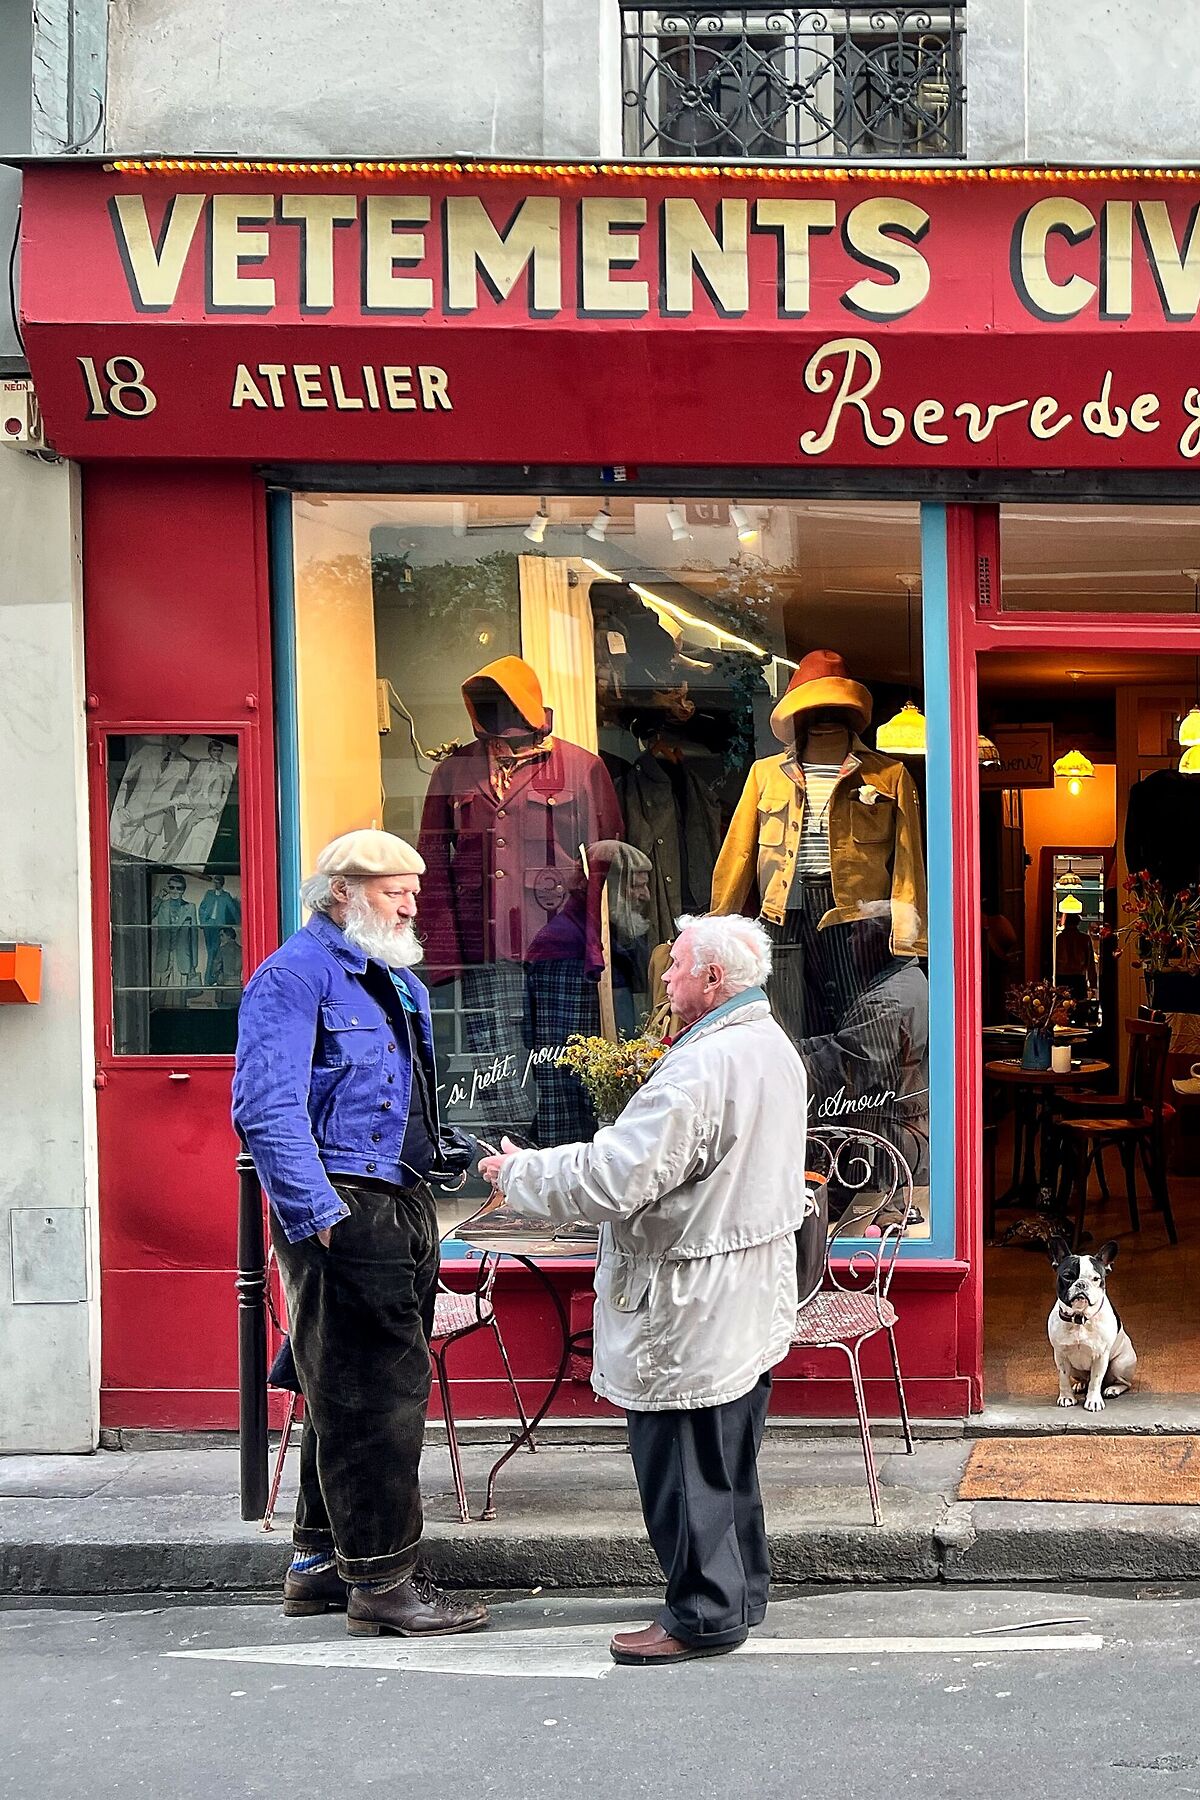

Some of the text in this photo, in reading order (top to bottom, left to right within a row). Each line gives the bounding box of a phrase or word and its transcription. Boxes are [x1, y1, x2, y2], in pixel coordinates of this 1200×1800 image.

[113, 194, 931, 317] VETEMENTS
[4, 383, 29, 391] NEON
[77, 356, 157, 417] 18
[232, 364, 453, 411] ATELIER
[818, 1085, 896, 1118] Amour
